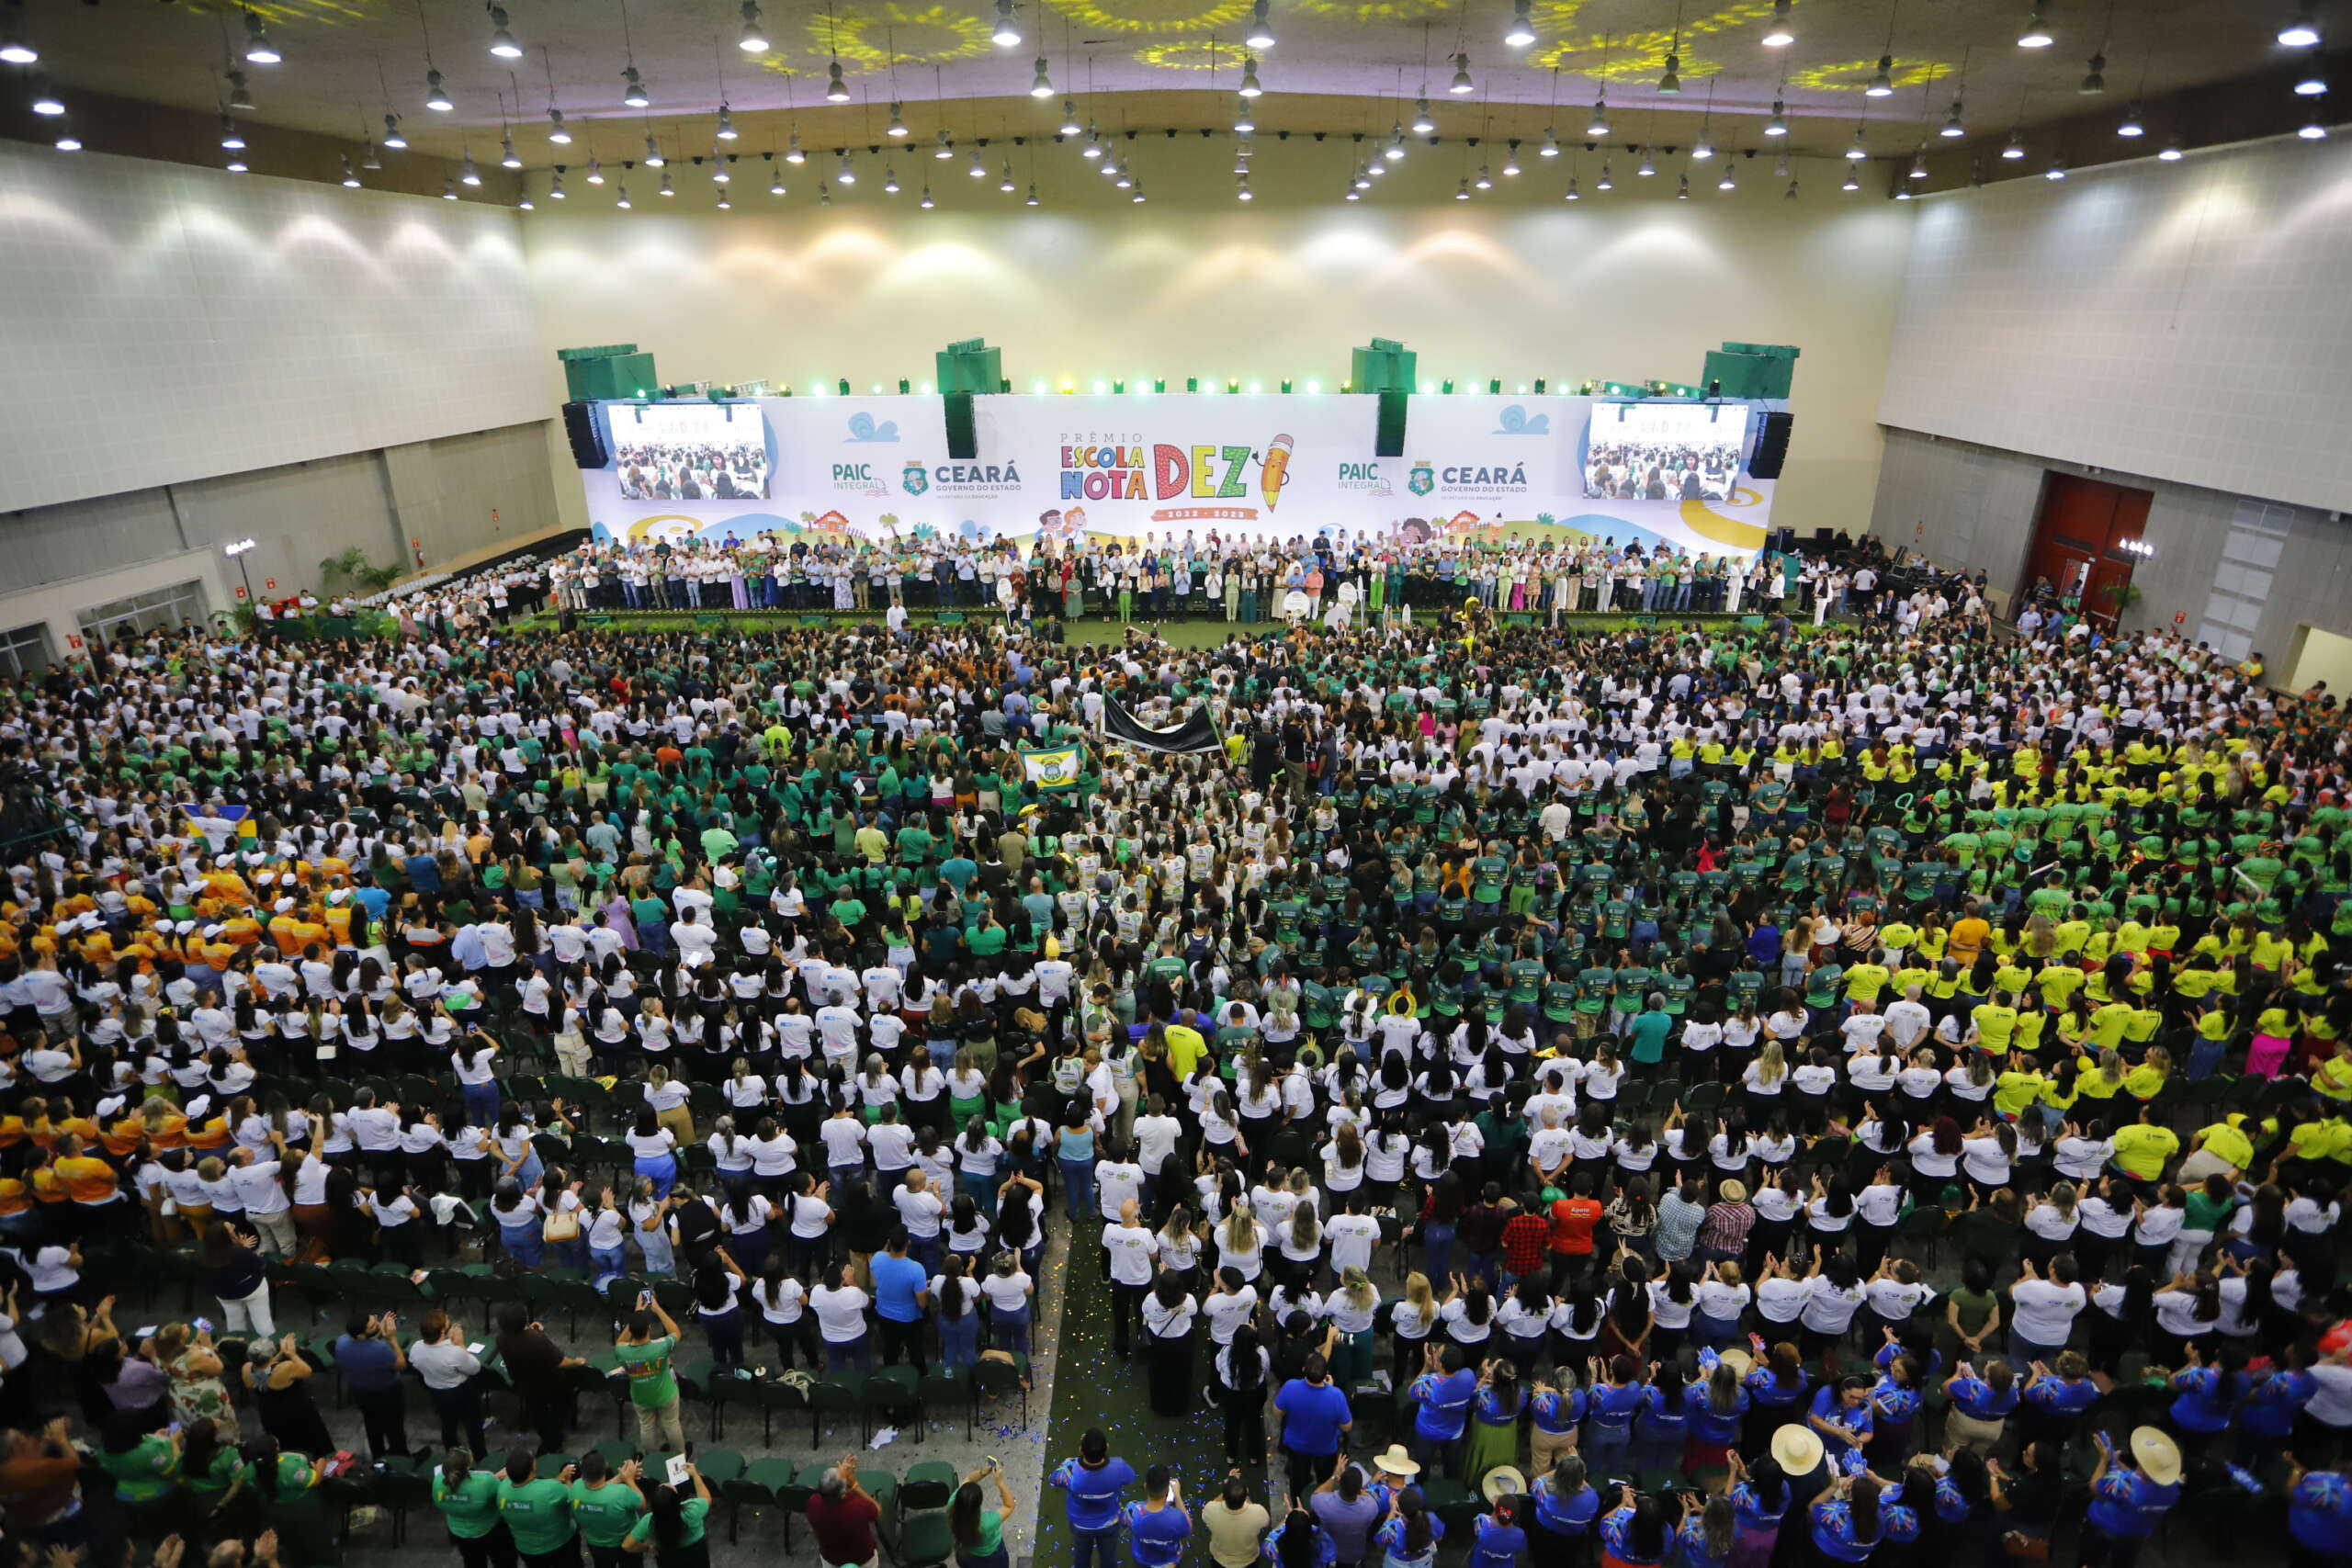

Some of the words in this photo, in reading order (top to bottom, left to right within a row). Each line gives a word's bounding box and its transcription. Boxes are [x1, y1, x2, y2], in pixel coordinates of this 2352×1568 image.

[1060, 431, 1142, 442] PRÊMIO
[1061, 446, 1145, 468] ESCOLA
[832, 464, 872, 480] PAIC
[935, 459, 1021, 483] CEARÁ
[1153, 444, 1251, 500] DEZ
[1339, 463, 1378, 480] PAIC
[1442, 461, 1527, 484] CEARÁ
[1061, 470, 1148, 500] NOTA
